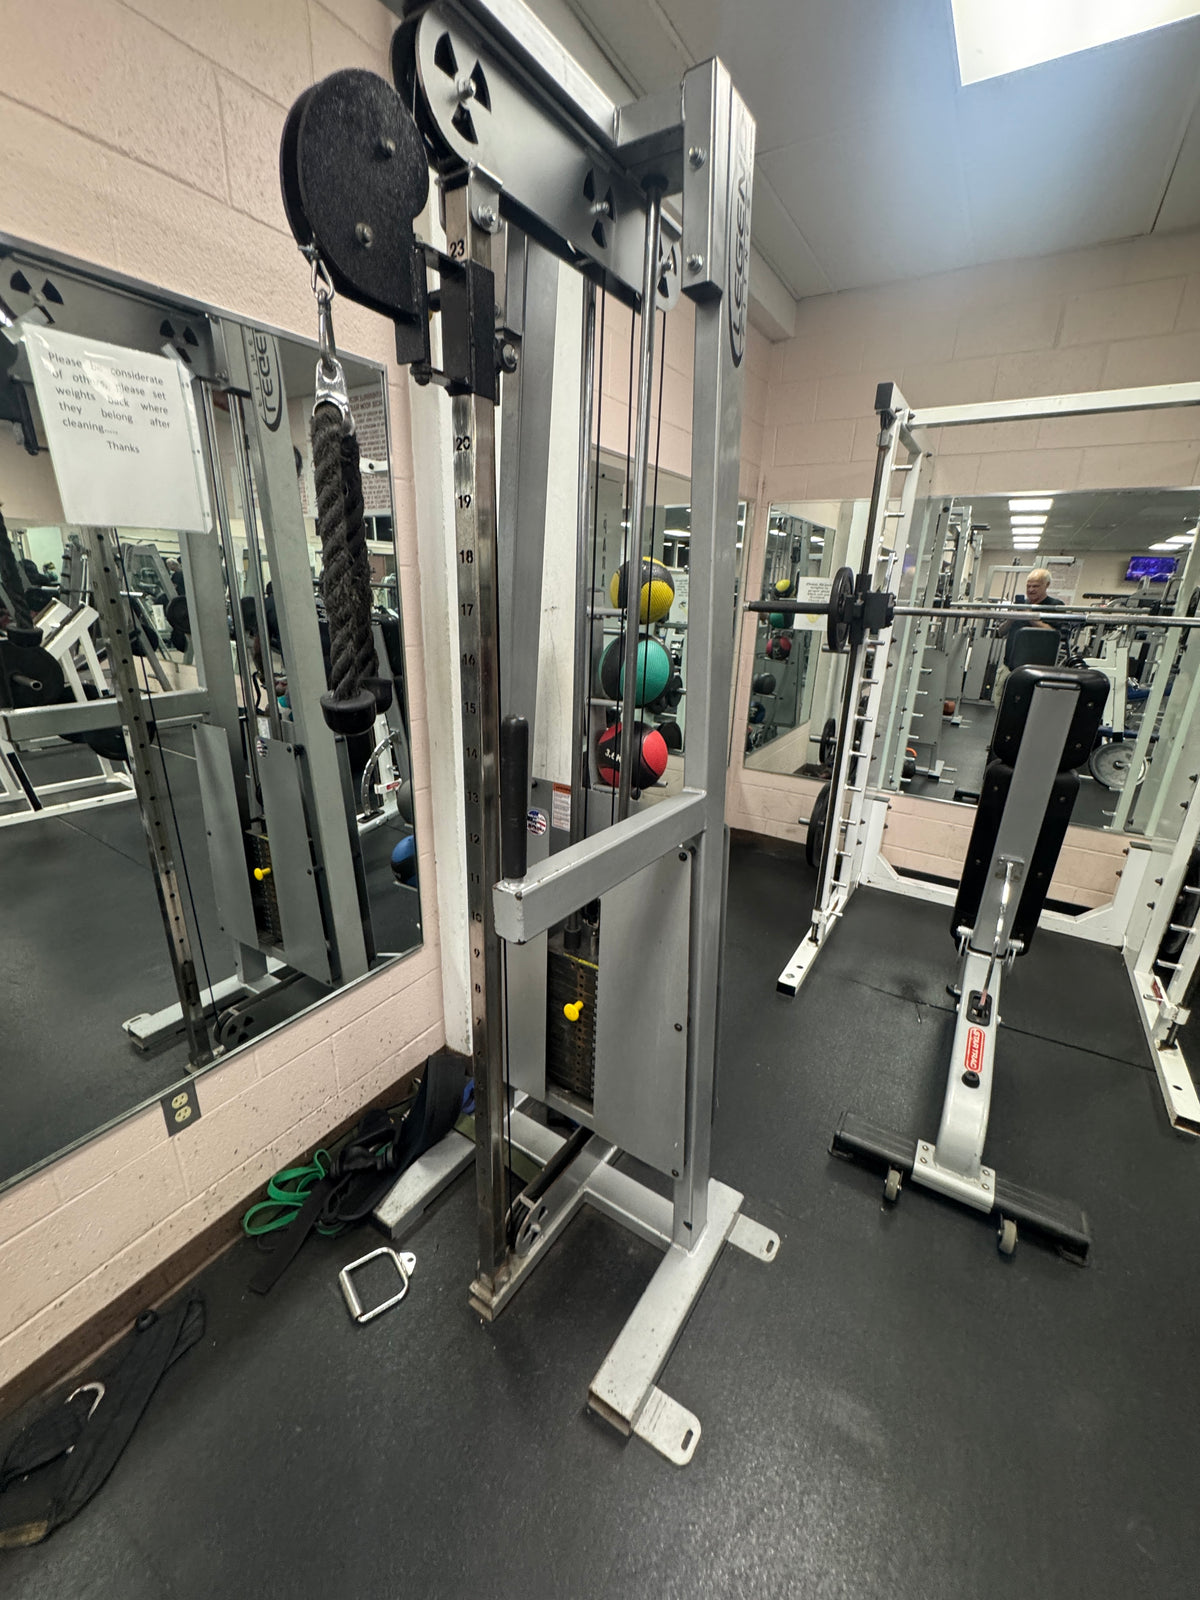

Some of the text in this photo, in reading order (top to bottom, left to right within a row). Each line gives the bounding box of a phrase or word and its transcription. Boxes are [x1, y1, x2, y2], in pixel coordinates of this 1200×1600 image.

[450, 239, 465, 258] 23
[48, 351, 82, 368] Please
[110, 367, 164, 386] considerate
[52, 368, 63, 380] of
[152, 390, 166, 401] set
[55, 386, 96, 401] weights
[140, 402, 168, 414] where
[59, 401, 170, 429] they belong after
[106, 440, 140, 454] Thanks
[456, 436, 471, 450] 20
[458, 494, 472, 509] 19
[459, 550, 473, 564] 18
[461, 603, 474, 617] 17
[462, 653, 476, 667] 16
[464, 701, 477, 715] 15
[466, 747, 478, 760] 14
[467, 791, 479, 803] 13
[469, 833, 480, 844] 12
[471, 872, 480, 884] 11
[471, 911, 482, 923] 10
[474, 948, 480, 958] 9
[475, 983, 481, 994] 8
[475, 1016, 482, 1026] 7
[970, 1049, 979, 1069] TRAC
